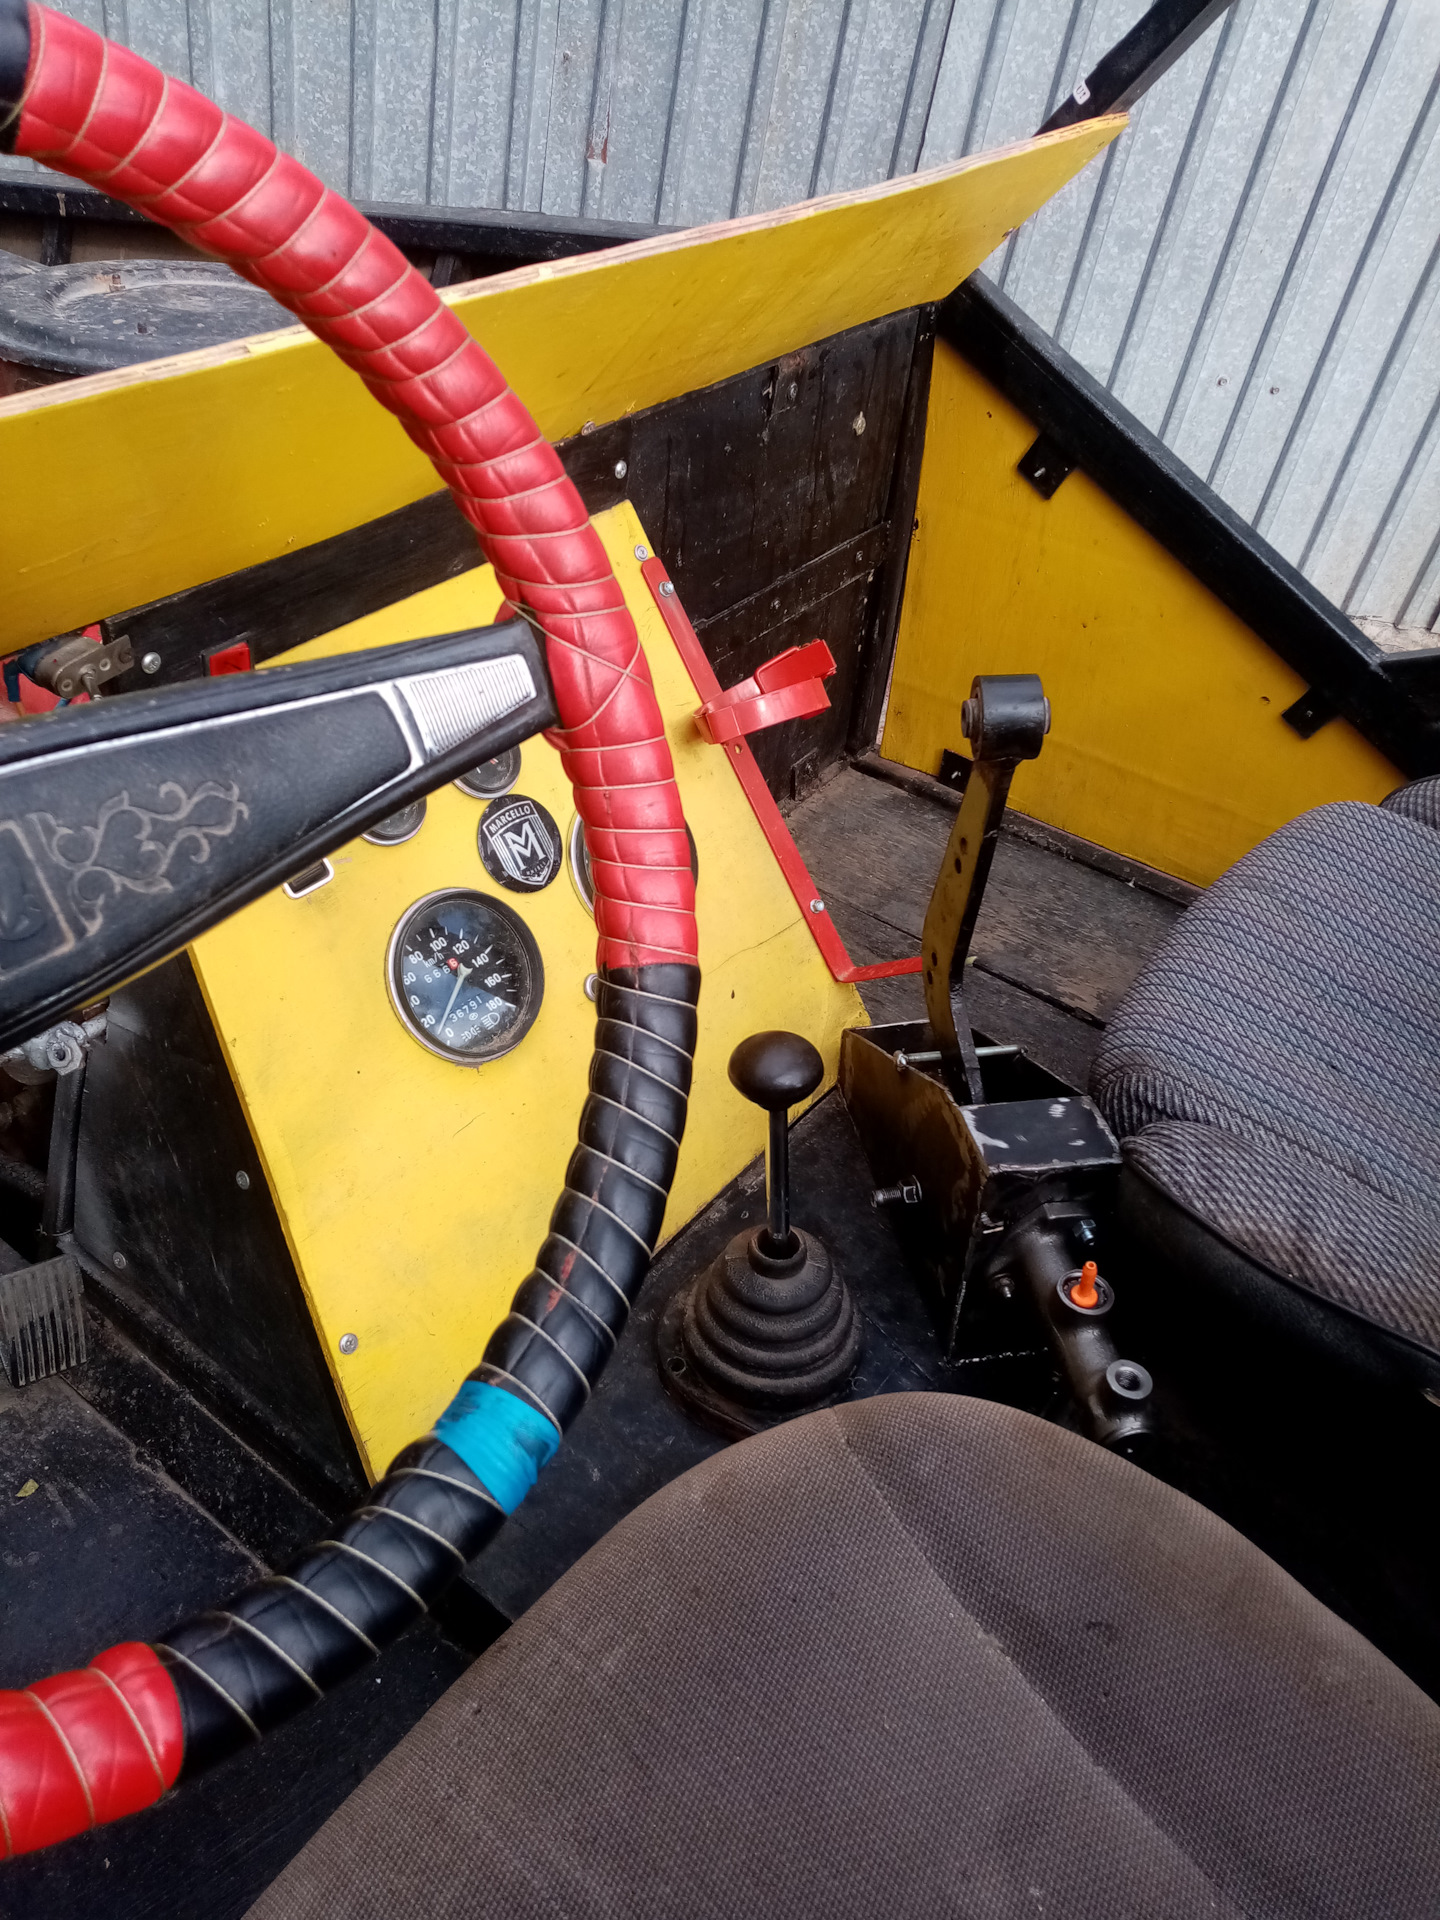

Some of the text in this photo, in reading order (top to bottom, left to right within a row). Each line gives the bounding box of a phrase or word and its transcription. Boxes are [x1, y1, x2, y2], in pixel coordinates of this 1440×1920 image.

[489, 806, 531, 833] MARCELLO
[430, 937, 447, 952] 100
[453, 941, 469, 955] 120
[409, 951, 423, 964] 80
[424, 952, 444, 968] km/h
[472, 954, 489, 967] 140
[403, 972, 416, 985] 60
[485, 974, 502, 987] 160
[410, 995, 420, 1008] 0
[486, 997, 503, 1011] 180
[422, 1015, 435, 1028] 20
[445, 1028, 454, 1038] 0
